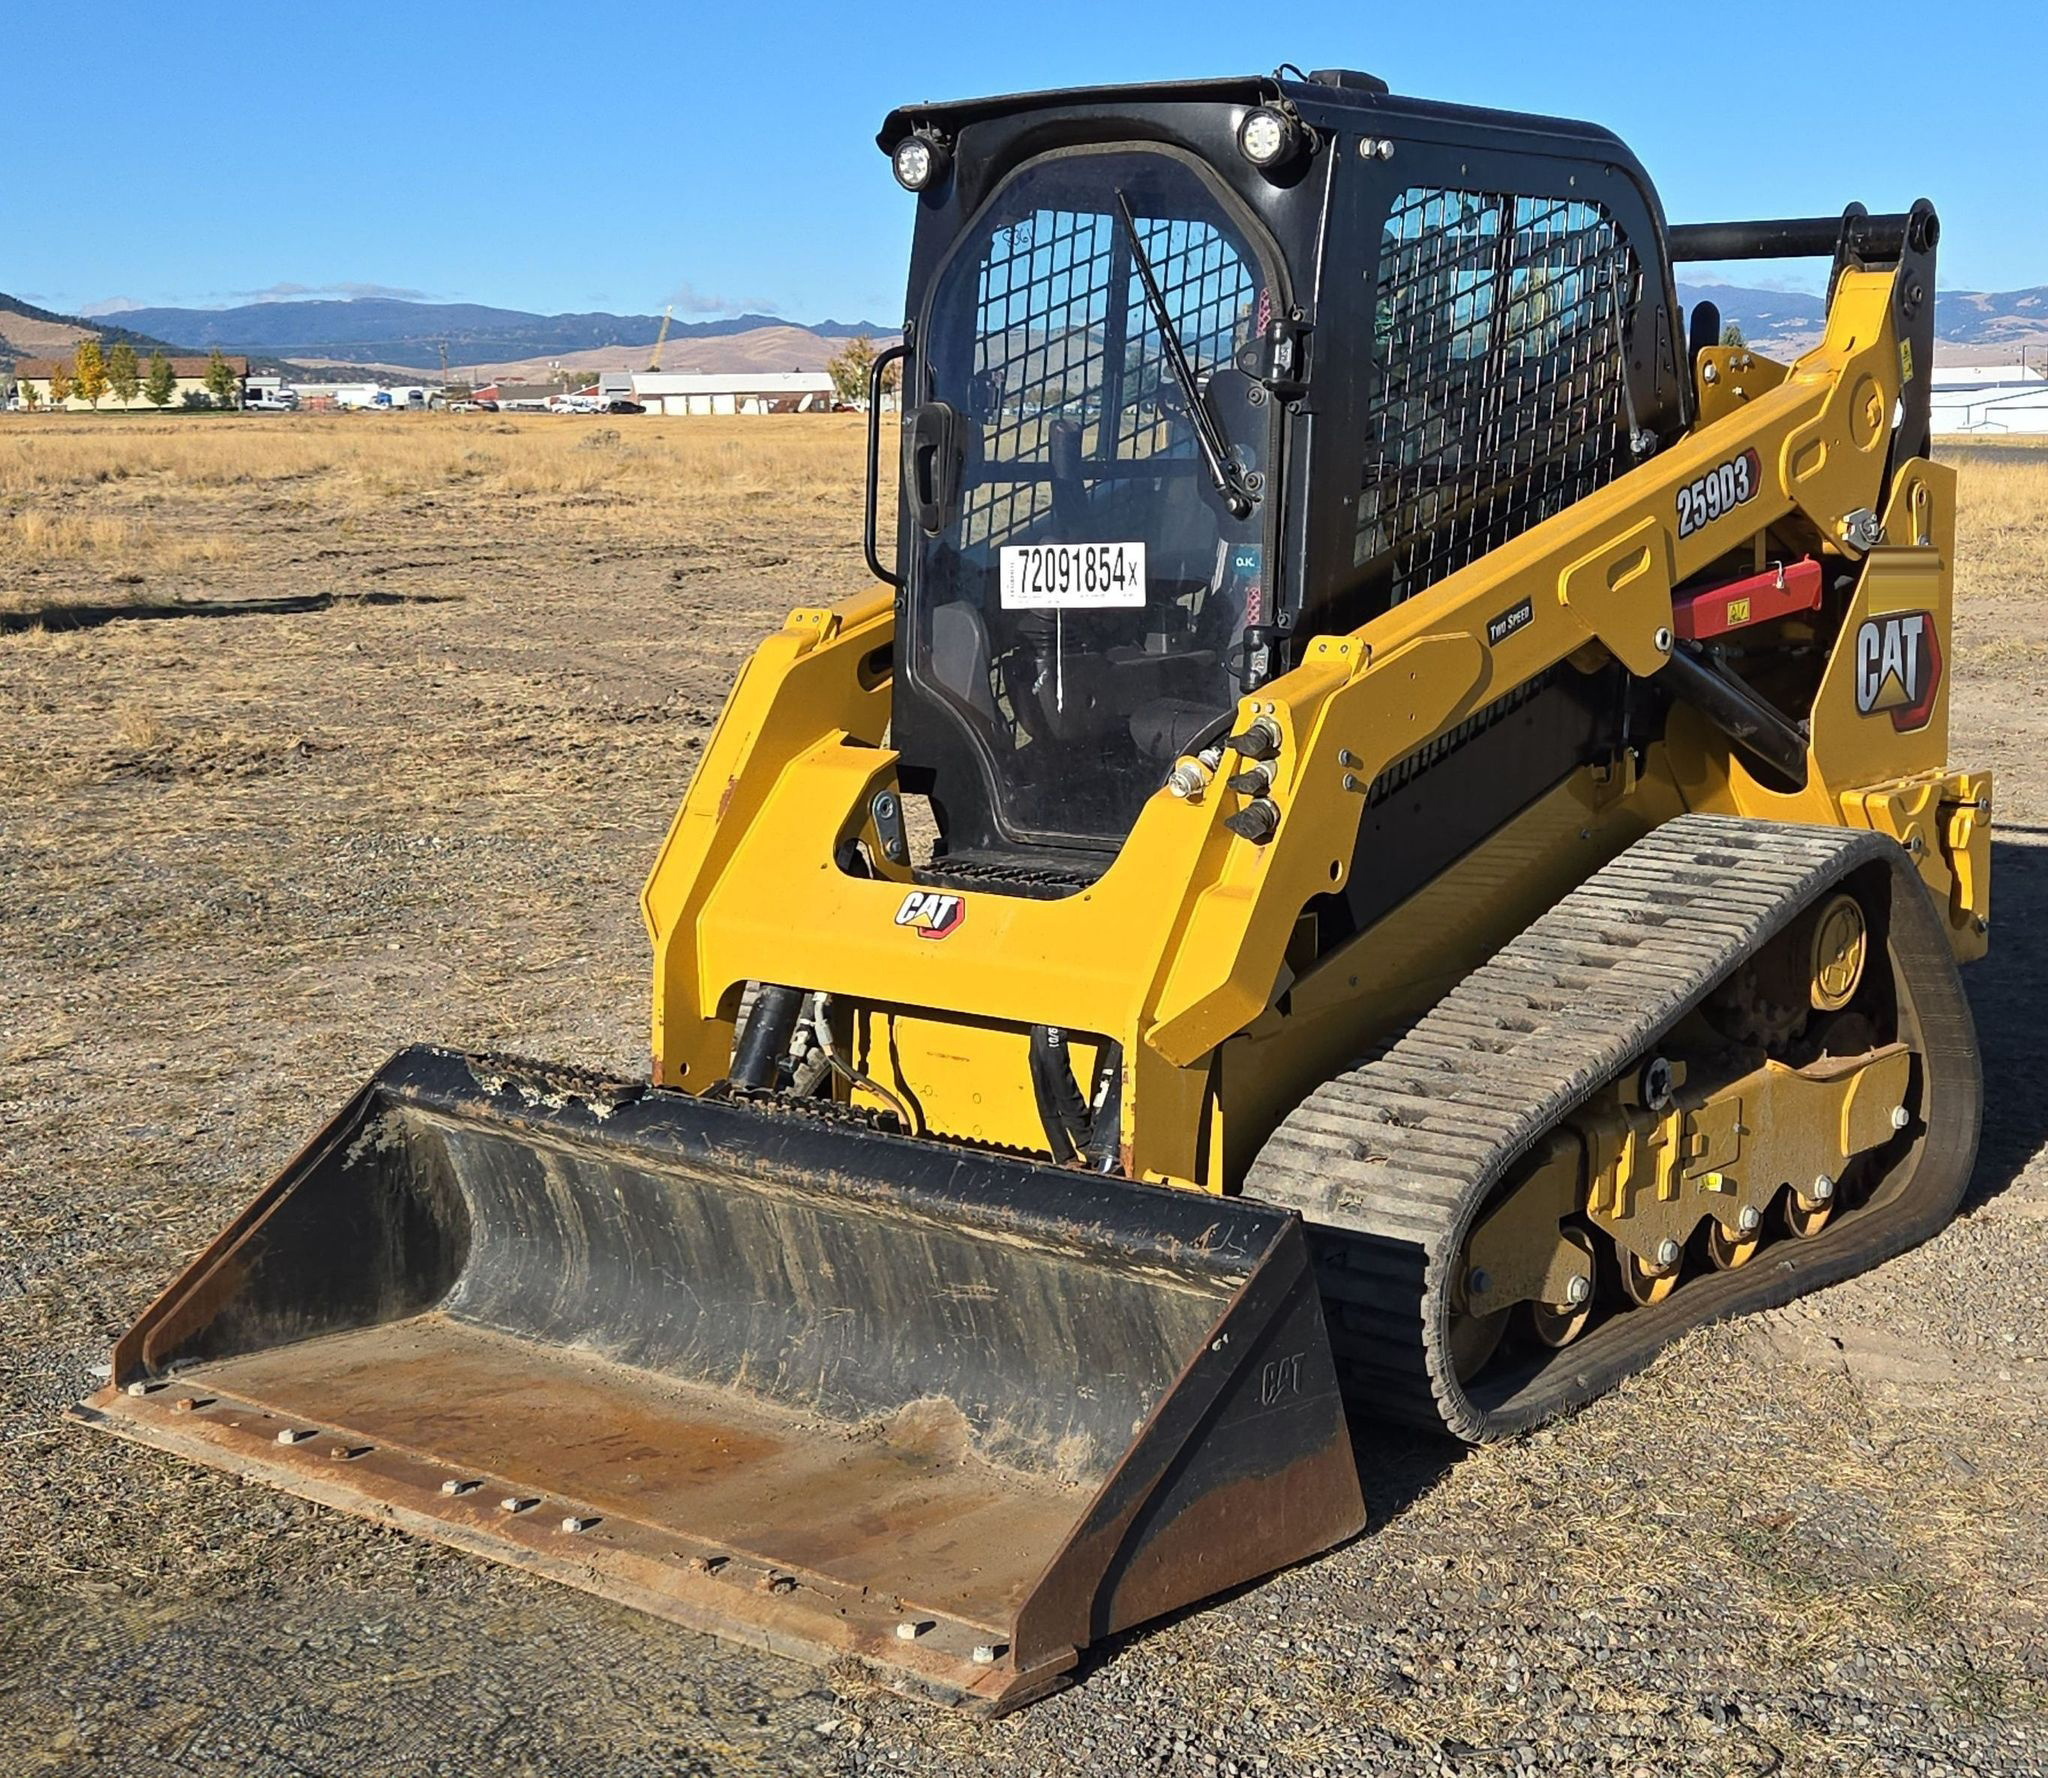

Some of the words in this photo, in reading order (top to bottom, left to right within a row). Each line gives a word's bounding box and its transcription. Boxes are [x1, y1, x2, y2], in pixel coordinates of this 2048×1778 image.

[1677, 455, 1750, 538] 259D3
[1857, 615, 1924, 712] CAT
[894, 891, 960, 929] CAT
[1262, 1352, 1305, 1406] CAT
